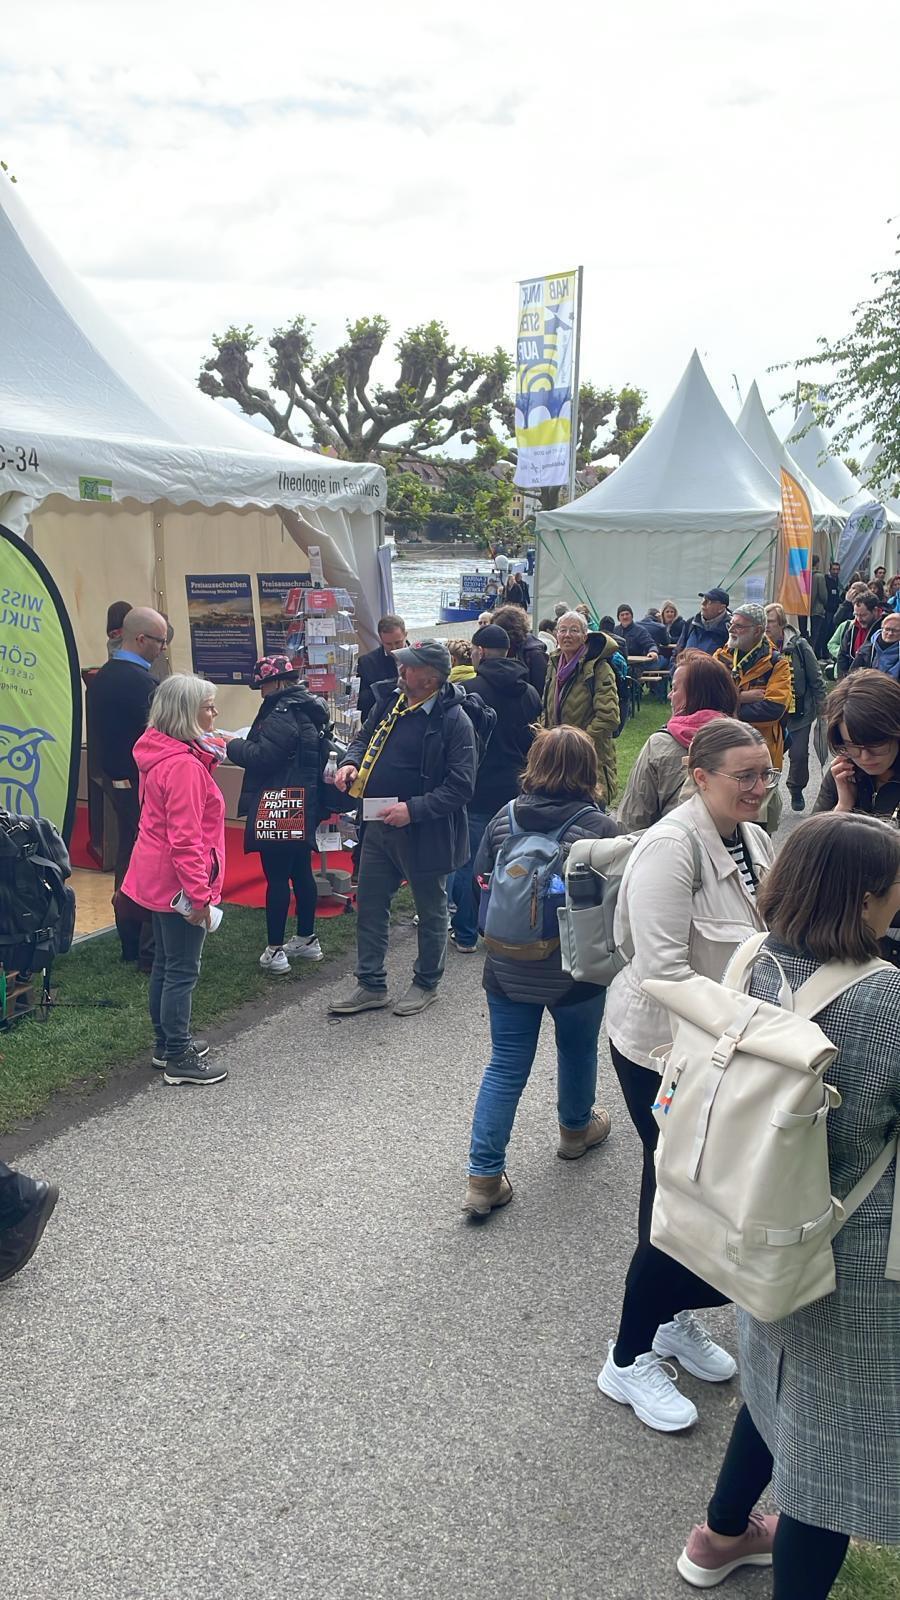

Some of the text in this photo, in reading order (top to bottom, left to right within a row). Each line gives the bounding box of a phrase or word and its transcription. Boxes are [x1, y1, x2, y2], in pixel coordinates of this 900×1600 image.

[277, 471, 380, 497] Theologie im Fernkurs
[190, 581, 248, 589] Preisausschreiben
[264, 799, 303, 809] PROFITE
[268, 809, 288, 819] MIT
[256, 820, 277, 829] DER
[256, 830, 289, 839] MIETE
